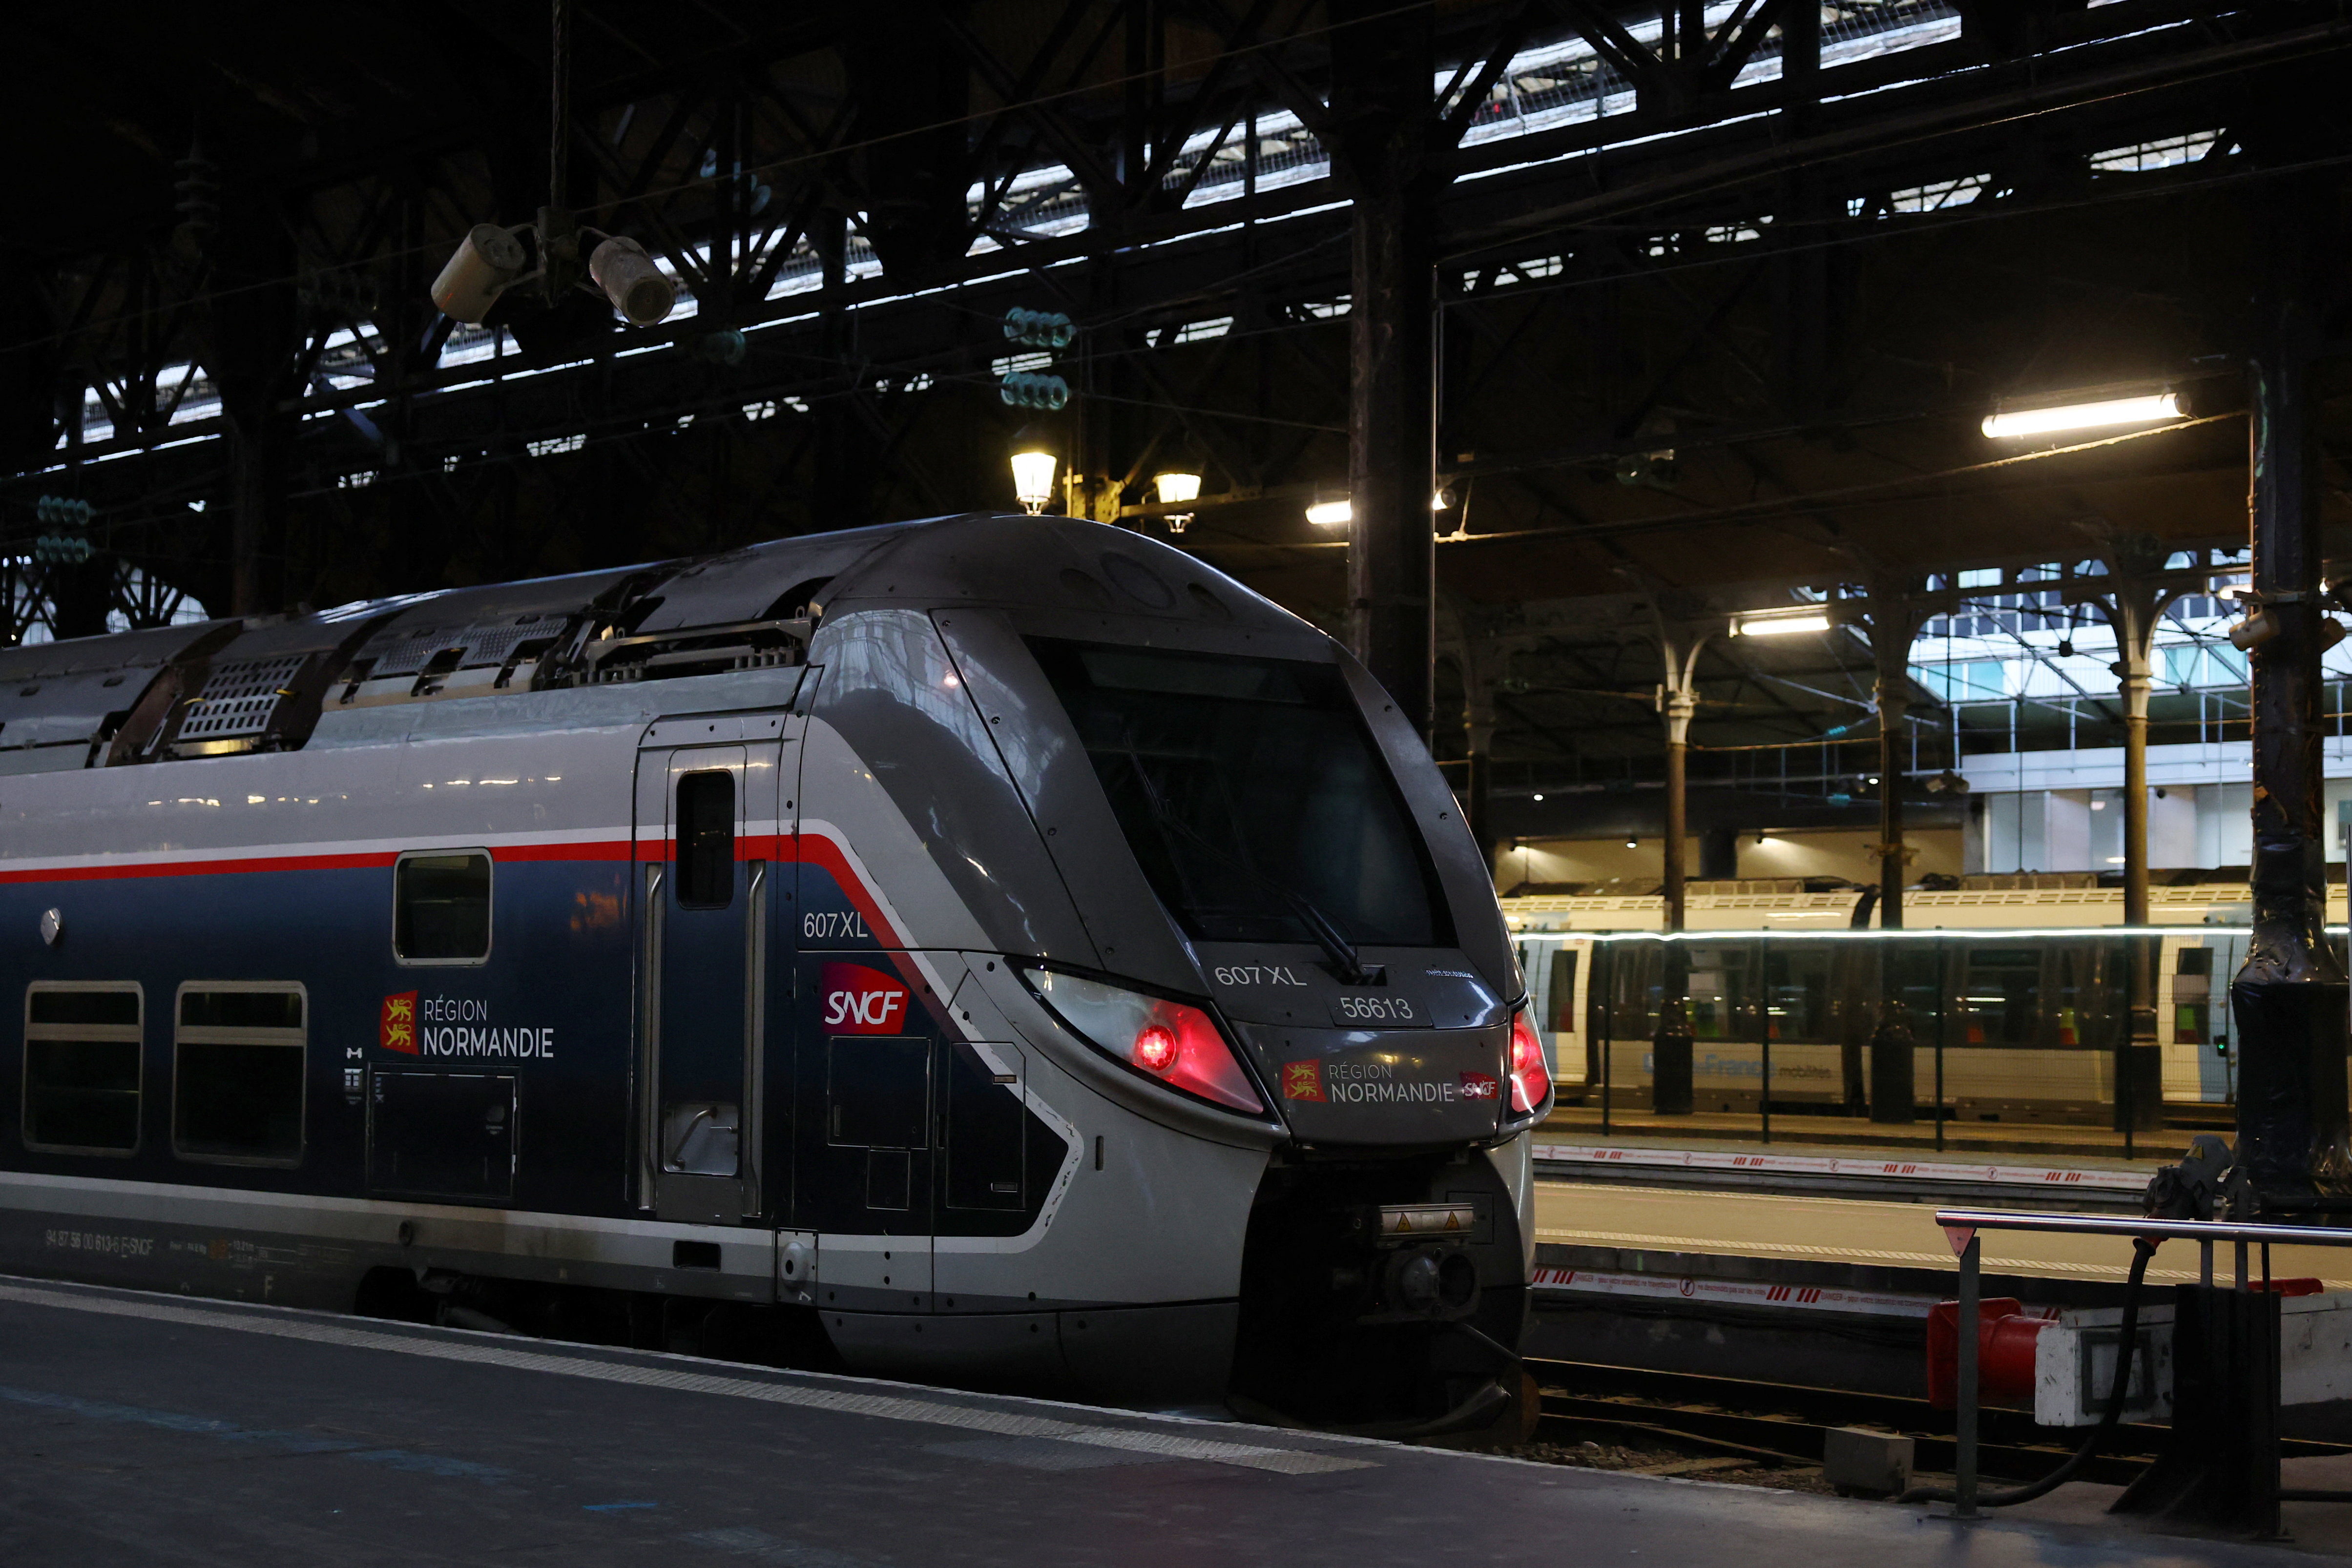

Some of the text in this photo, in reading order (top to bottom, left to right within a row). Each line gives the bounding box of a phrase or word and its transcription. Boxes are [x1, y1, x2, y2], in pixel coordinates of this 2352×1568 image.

[804, 911, 868, 938] 607XL
[1215, 967, 1307, 986] 607XL
[424, 994, 487, 1021] RÉGION
[825, 990, 903, 1025] SNCF
[1340, 997, 1413, 1019] 56613
[424, 1027, 554, 1058] NORMANDIE
[1329, 1062, 1392, 1079] RÉGION
[1332, 1083, 1454, 1102] NORMANDIE
[1464, 1081, 1496, 1097] SNCF
[46, 1229, 56, 1245] 94
[58, 1230, 68, 1246] 87
